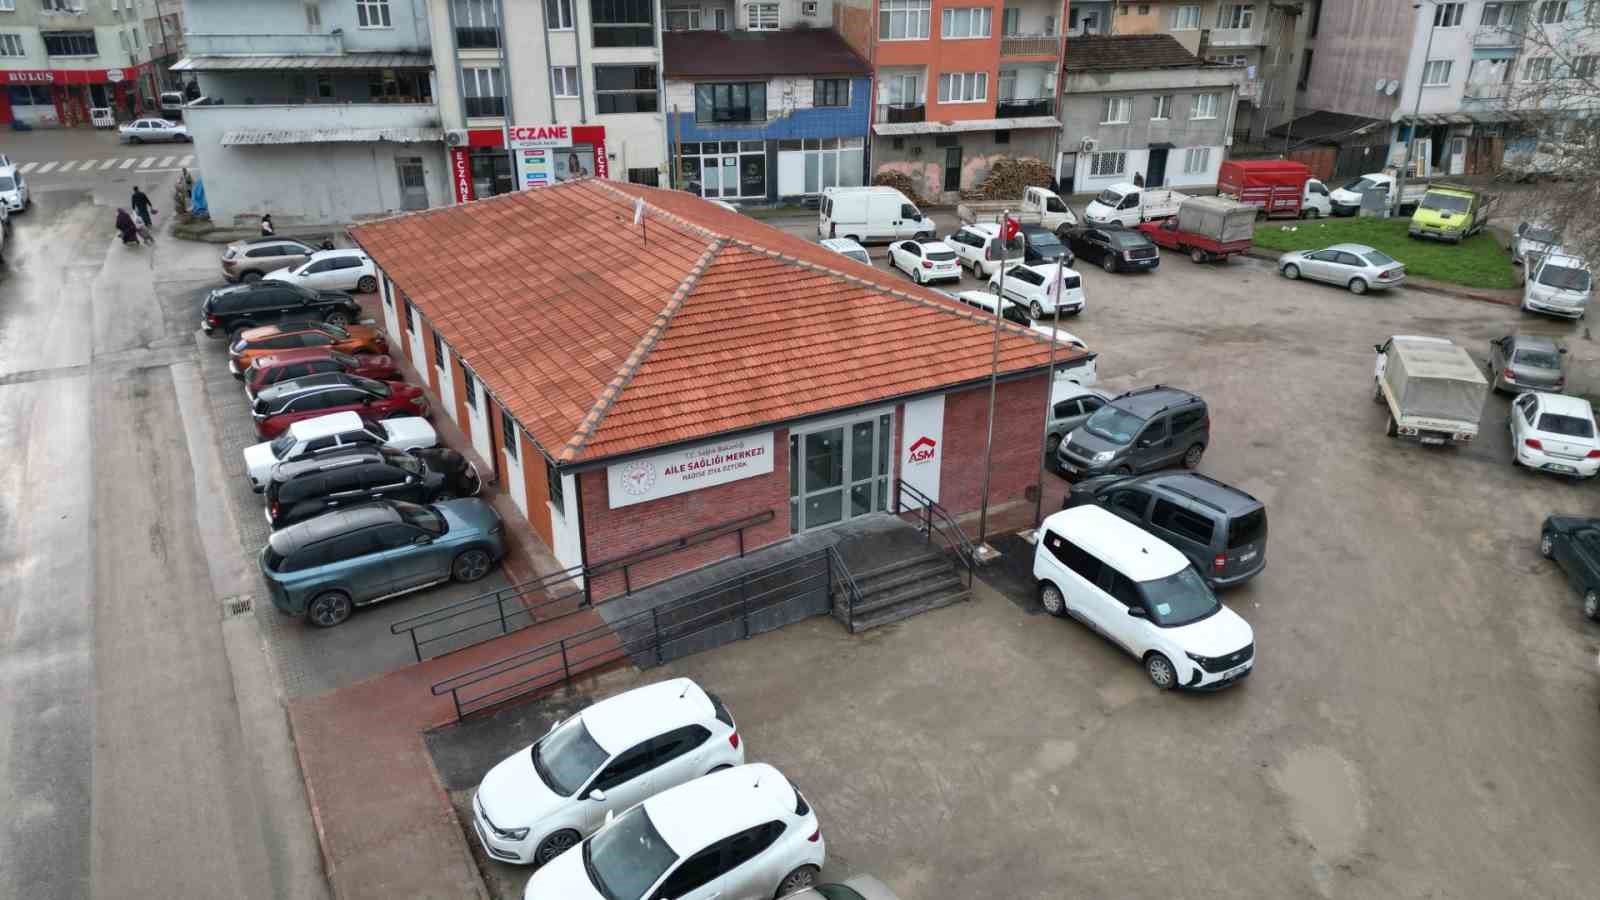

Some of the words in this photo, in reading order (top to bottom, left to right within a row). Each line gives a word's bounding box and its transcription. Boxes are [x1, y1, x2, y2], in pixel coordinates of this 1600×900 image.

[509, 126, 568, 140] ECZANE
[664, 463, 686, 476] AİLE
[687, 454, 724, 471] SAĞLIĞI
[726, 446, 764, 461] MERKEZİ
[908, 448, 935, 463] ASM
